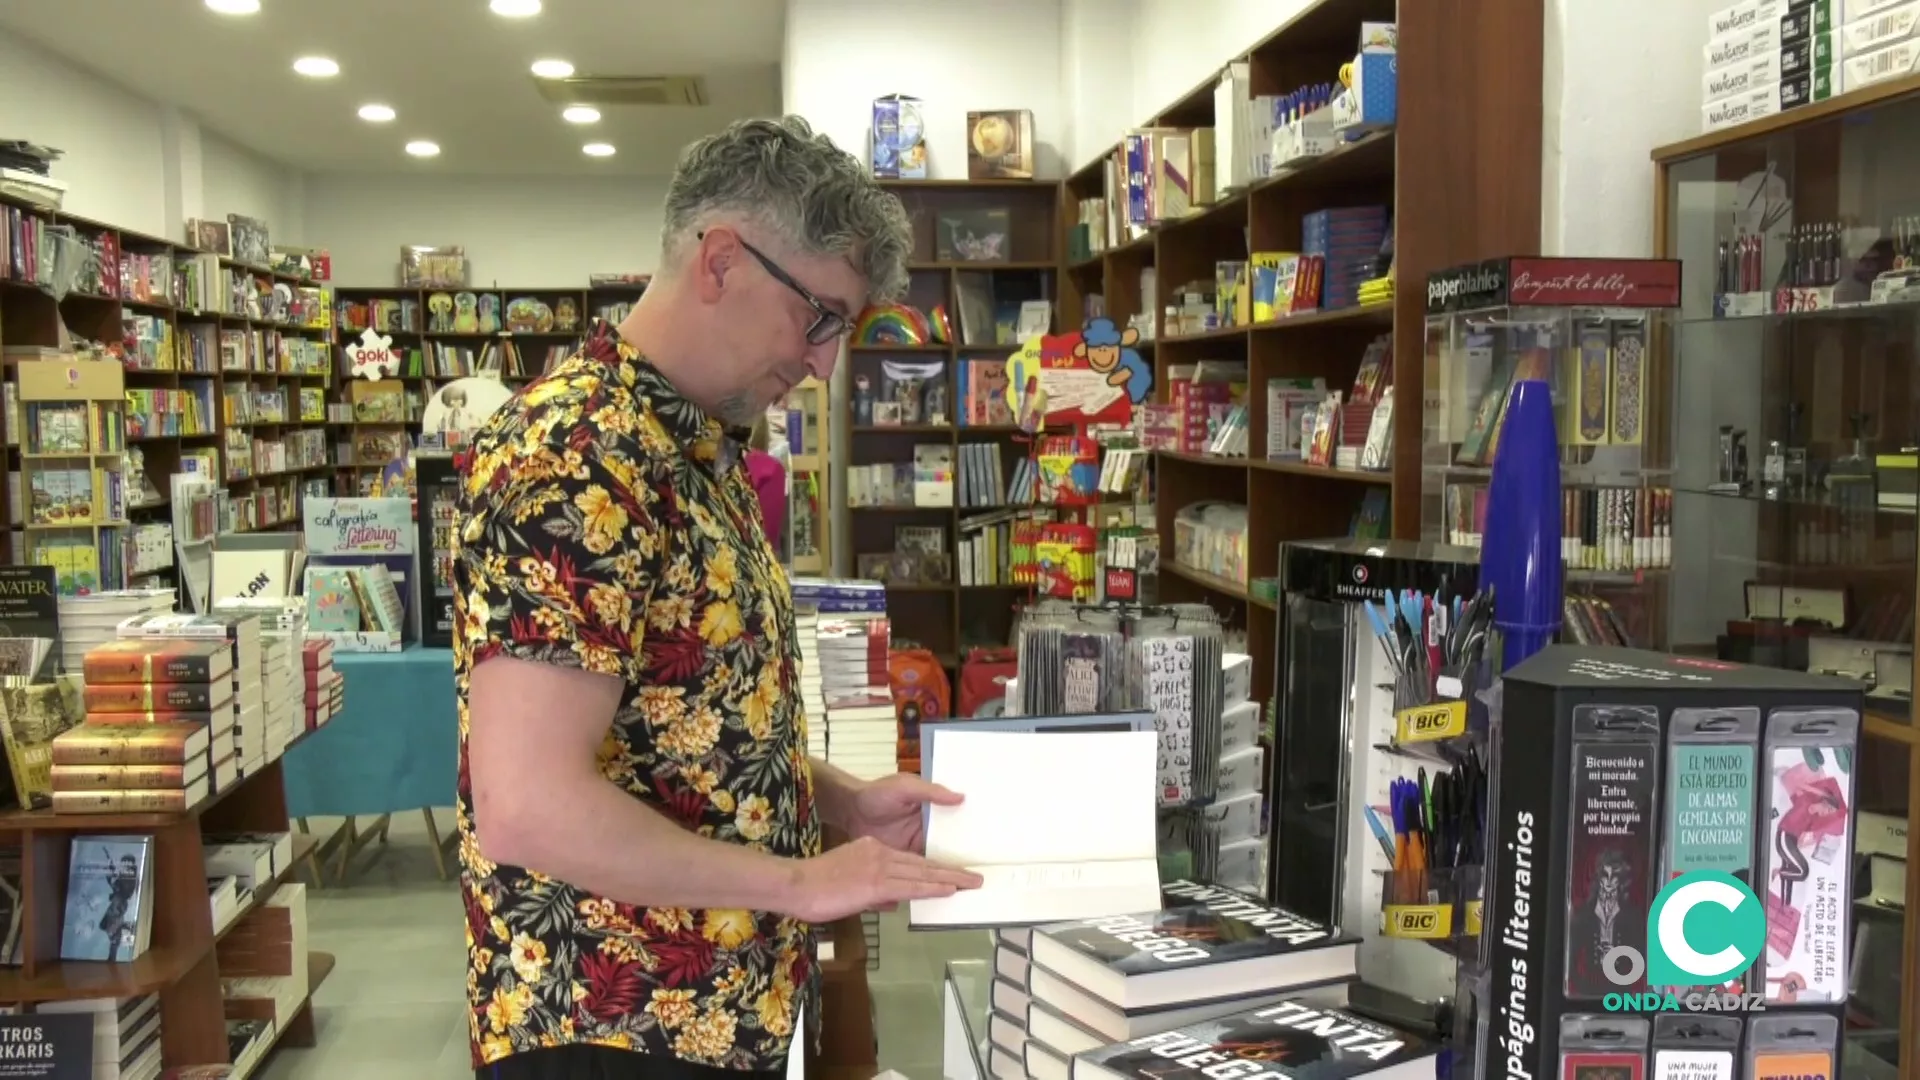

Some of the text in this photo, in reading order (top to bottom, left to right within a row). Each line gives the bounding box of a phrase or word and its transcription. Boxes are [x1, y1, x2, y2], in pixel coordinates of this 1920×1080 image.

[1716, 9, 1756, 34] NAVIGATOR
[1711, 42, 1749, 65] NAVIGATOR
[1710, 73, 1748, 95] NAVIGATOR
[1709, 104, 1748, 125] NAVIGATOR
[1427, 268, 1499, 306] paperblanks
[356, 349, 388, 366] goki
[1336, 584, 1385, 598] SHEAFFER
[1416, 713, 1448, 729] BIC
[1585, 756, 1637, 768] Bienvenido
[1689, 755, 1742, 770] EL MUNDO
[1589, 770, 1600, 780] mi
[1705, 773, 1747, 789] REPLETO
[1688, 792, 1738, 808] DE ALMAS
[1584, 812, 1598, 824] por
[1611, 812, 1640, 824] propia
[1679, 811, 1746, 826] GEMELAS POR
[1681, 829, 1743, 845] ENCONTRAR
[1827, 896, 1837, 921] ACTO
[1404, 915, 1433, 928] BIC
[1083, 914, 1210, 962] FUEGO
[1499, 811, 1534, 1080] páginas literarios
[1255, 1001, 1405, 1060] TINTA
[1668, 1063, 1718, 1071] UNA MUJER
